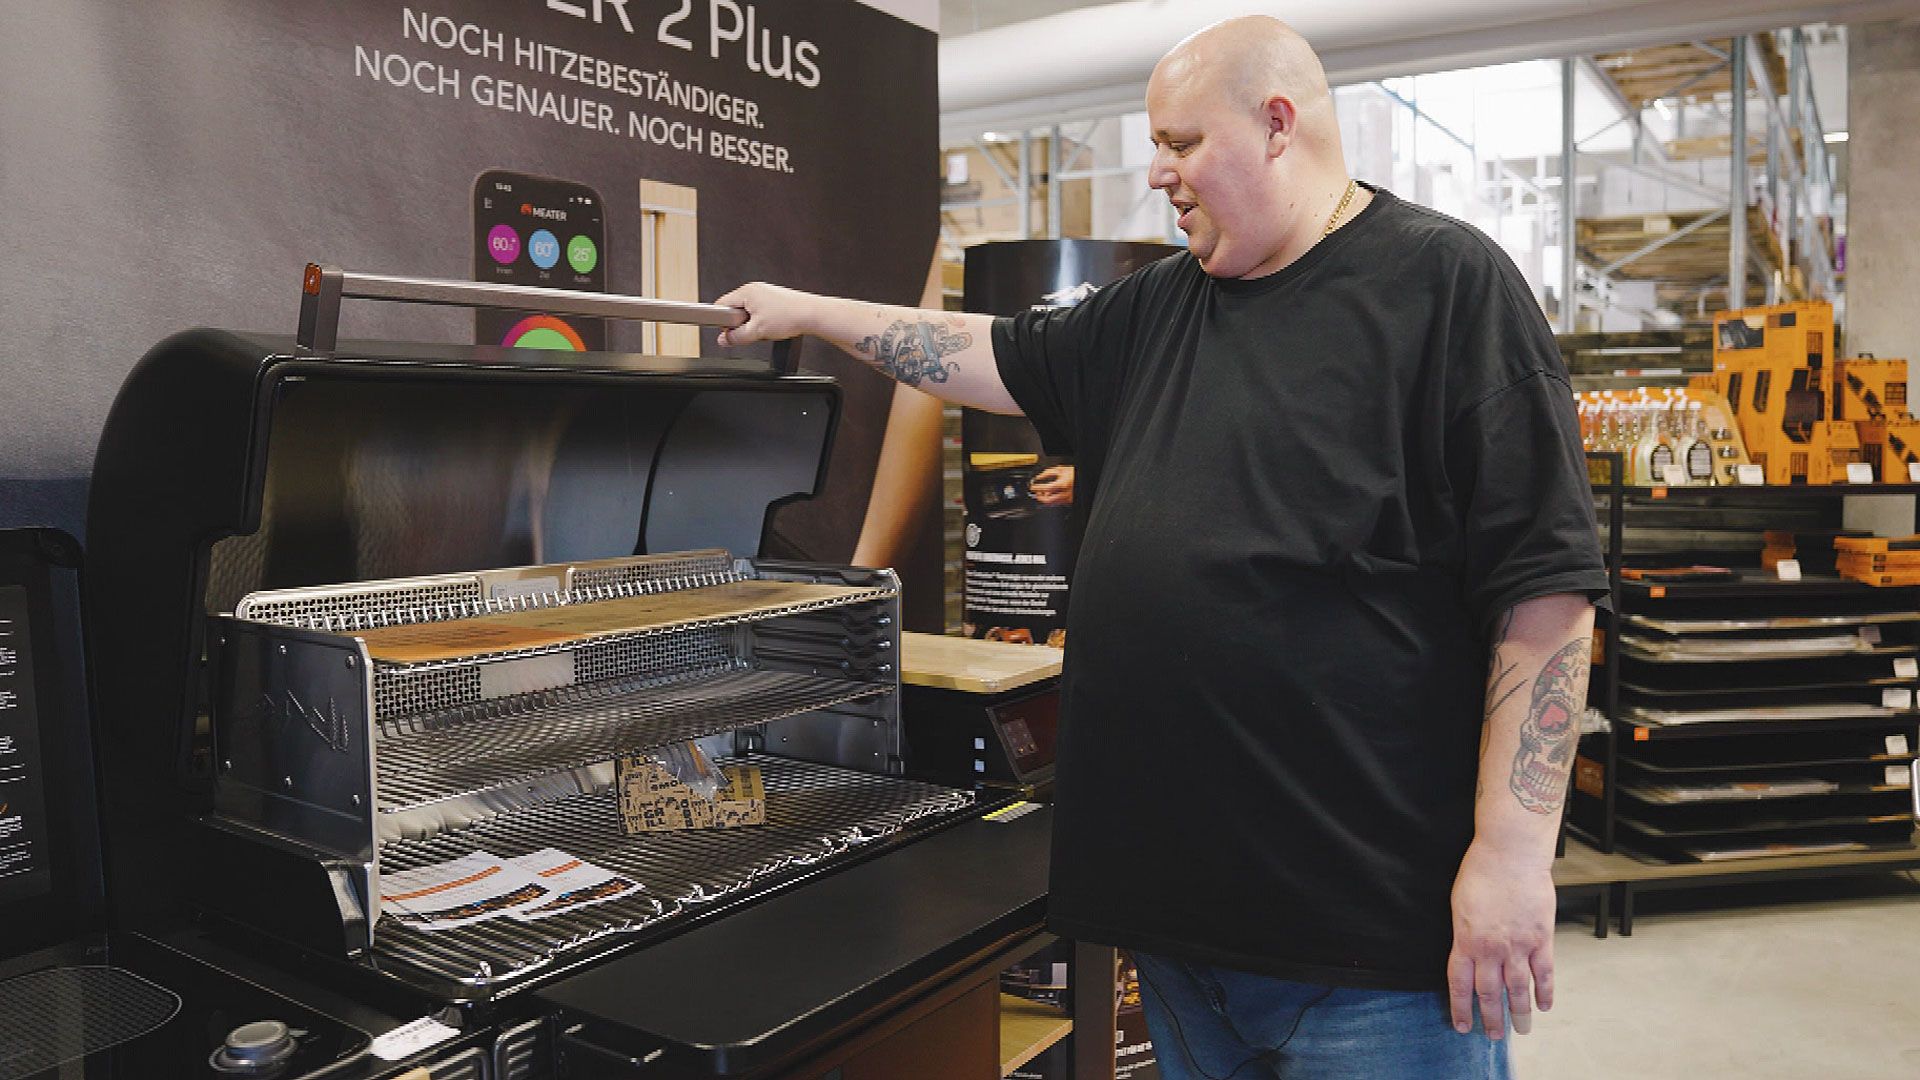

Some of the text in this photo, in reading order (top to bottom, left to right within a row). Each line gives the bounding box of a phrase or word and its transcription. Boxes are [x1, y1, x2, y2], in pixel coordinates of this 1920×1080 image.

[403, 7, 504, 62] NOCH
[515, 37, 764, 129] HITZEBESTÄNDIGER.
[657, 0, 693, 51] 2
[710, 0, 821, 88] Plus
[354, 45, 794, 173] NOCH GENAUER. NOCH BESSER.
[532, 207, 567, 221] MEATER
